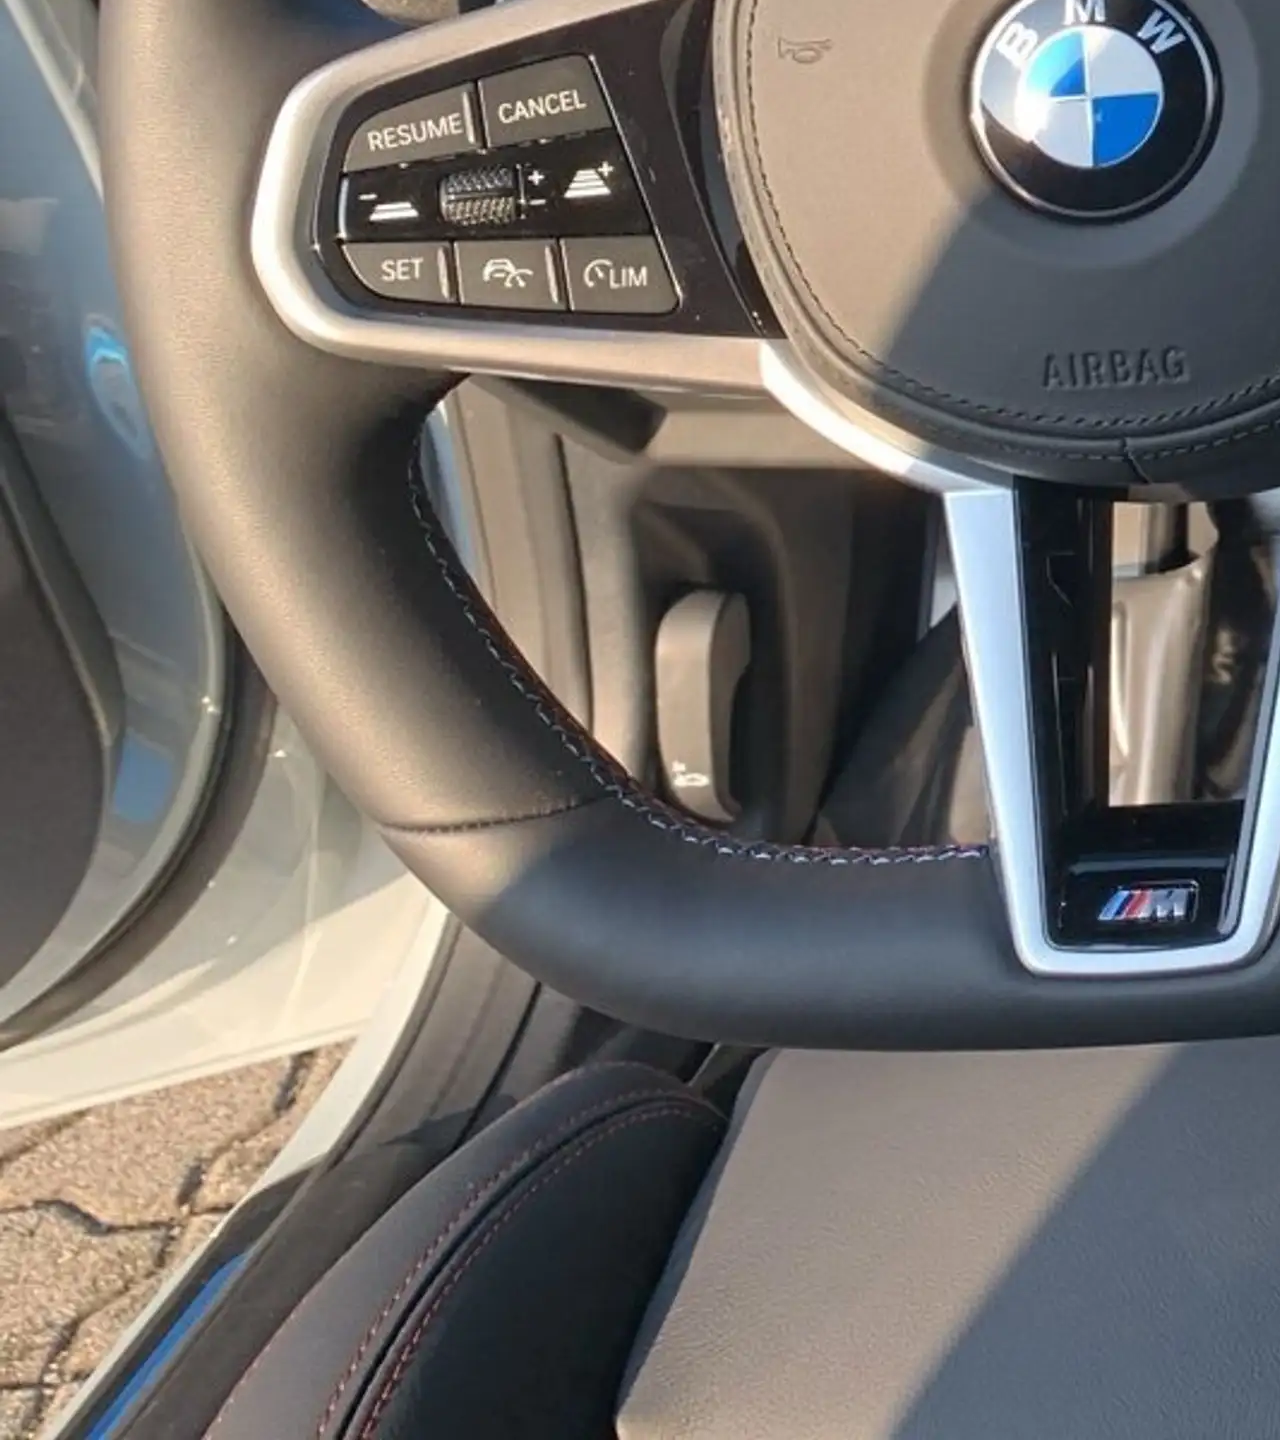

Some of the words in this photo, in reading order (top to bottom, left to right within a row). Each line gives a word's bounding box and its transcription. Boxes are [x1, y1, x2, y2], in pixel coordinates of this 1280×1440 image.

[498, 89, 587, 124] CANCEL
[367, 112, 462, 152] RESUME
[381, 258, 424, 282] SET
[609, 266, 648, 289] LIM
[1042, 345, 1188, 389] AIRBAG
